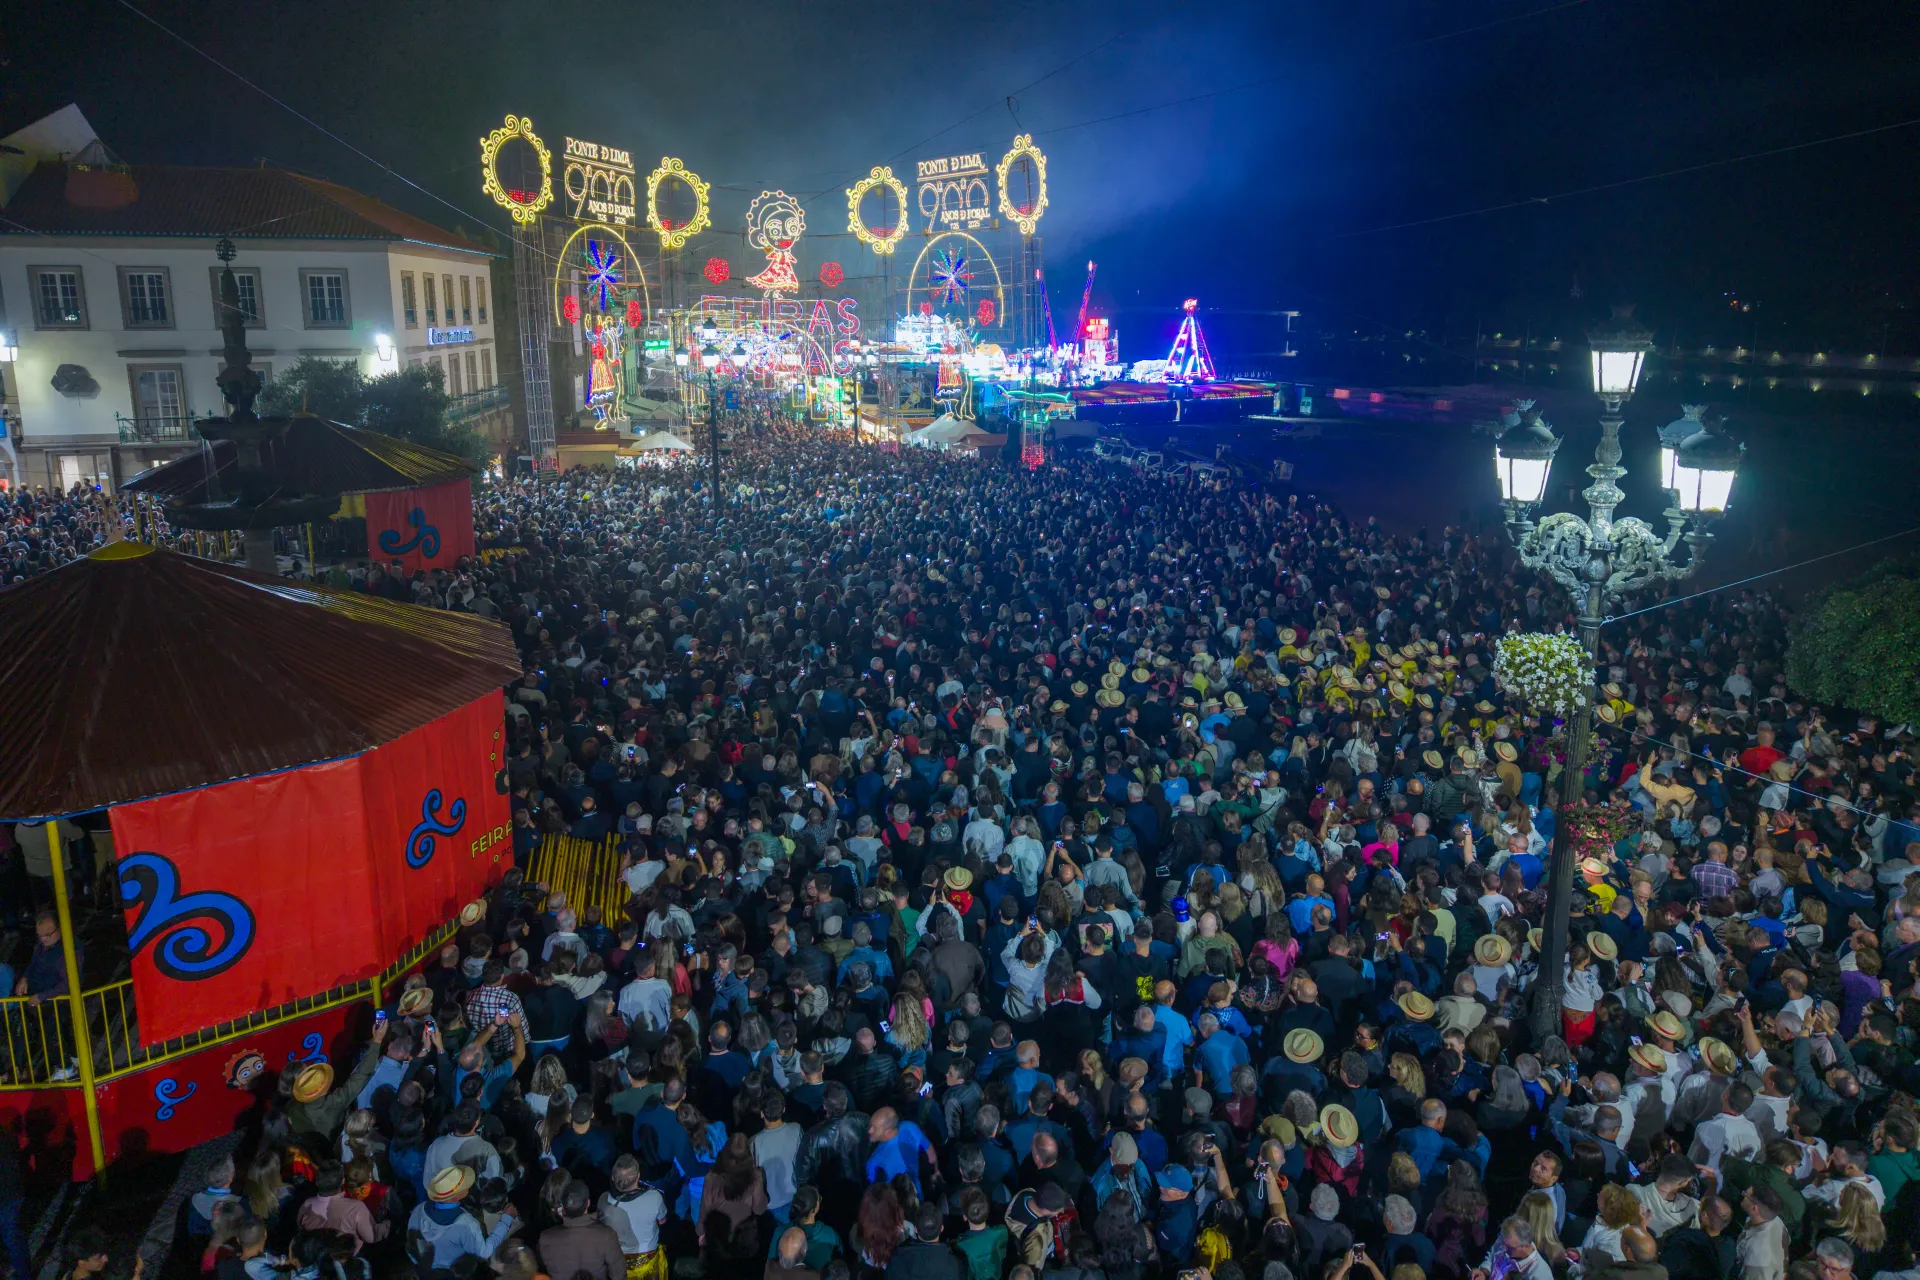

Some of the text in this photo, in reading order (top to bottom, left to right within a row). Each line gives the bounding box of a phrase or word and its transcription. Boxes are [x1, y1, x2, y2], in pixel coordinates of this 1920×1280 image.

[566, 137, 598, 159] PONTE
[918, 158, 948, 177] PONTE
[471, 819, 513, 859] FEIRA
